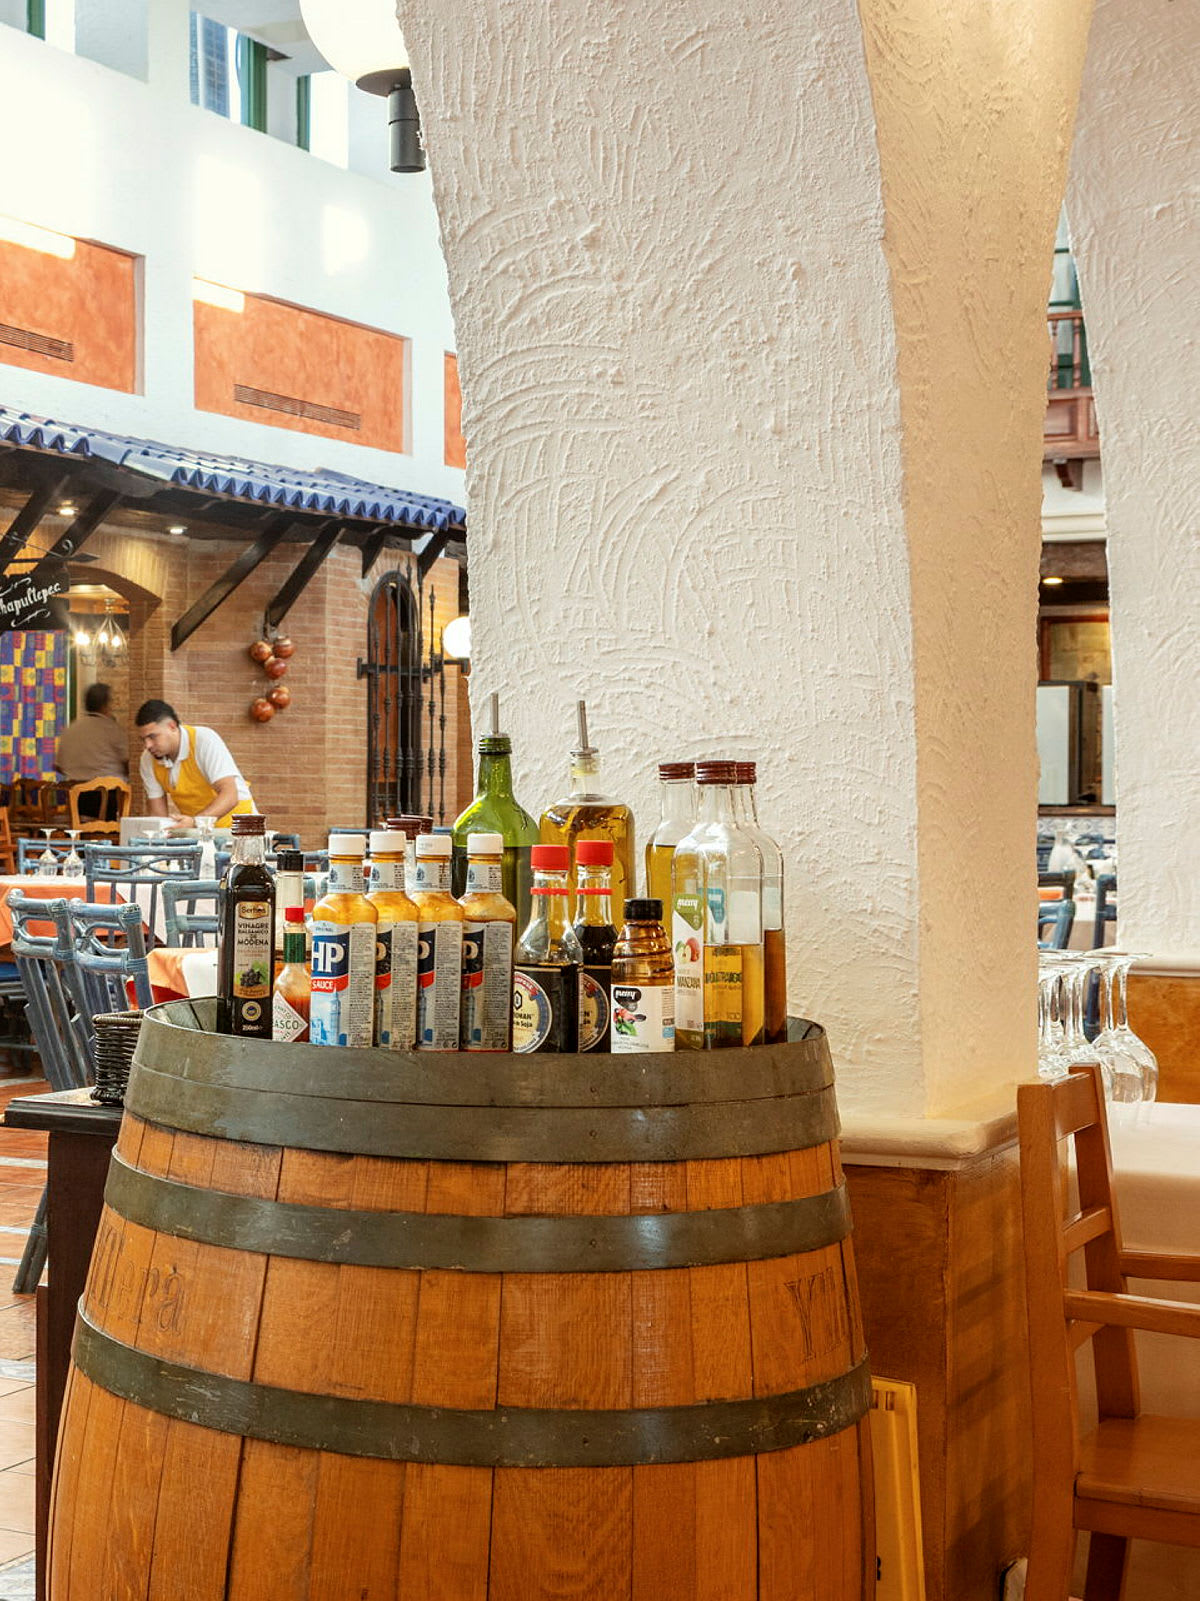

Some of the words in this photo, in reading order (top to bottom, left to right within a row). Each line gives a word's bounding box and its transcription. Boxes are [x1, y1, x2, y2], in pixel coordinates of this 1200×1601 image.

[237, 938, 269, 946] MODENA
[311, 941, 344, 972] HP
[311, 980, 334, 991] SAUCE
[274, 1019, 299, 1030] ASCO
